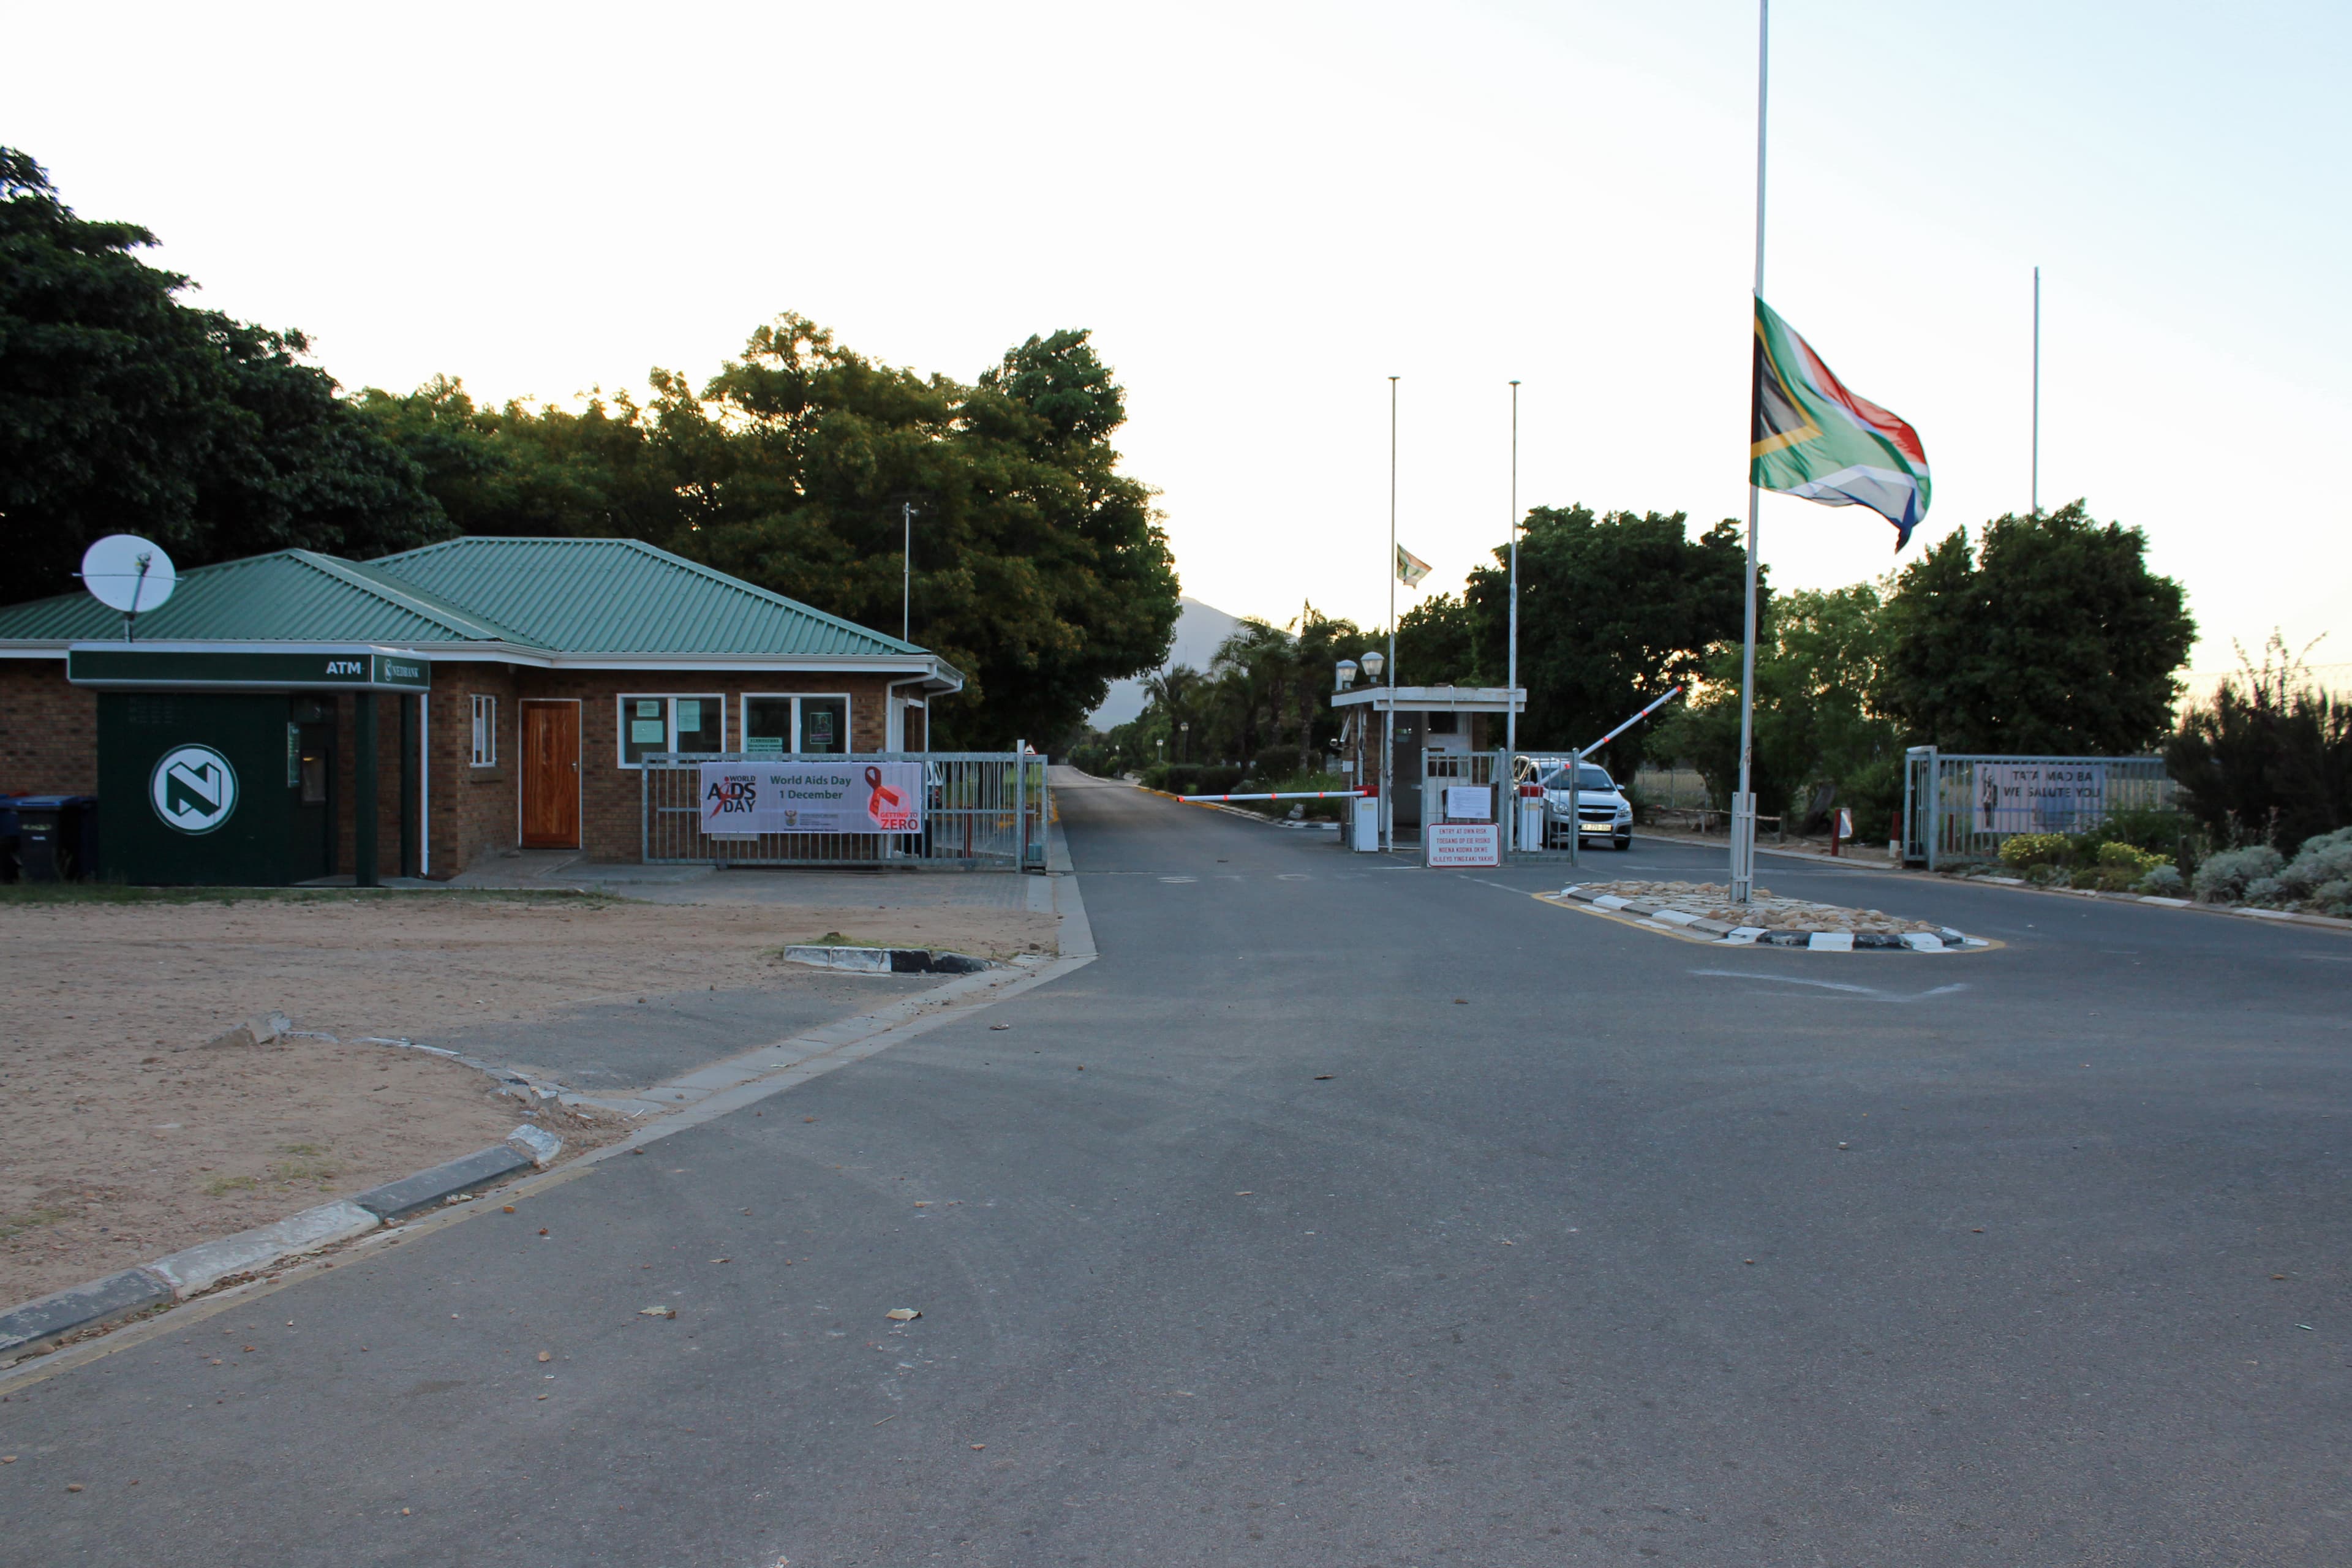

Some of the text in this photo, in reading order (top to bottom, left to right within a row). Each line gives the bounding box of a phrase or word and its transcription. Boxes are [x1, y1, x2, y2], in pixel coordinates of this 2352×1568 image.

[326, 661, 361, 674] ATM
[392, 666, 419, 678] NEDBANK
[770, 775, 851, 787] World Aids Day
[2047, 771, 2093, 782] MADBA
[779, 790, 843, 799] 1 December
[2028, 787, 2071, 797] SALUTE
[723, 800, 756, 813] DAY
[881, 819, 918, 830] ZERO
